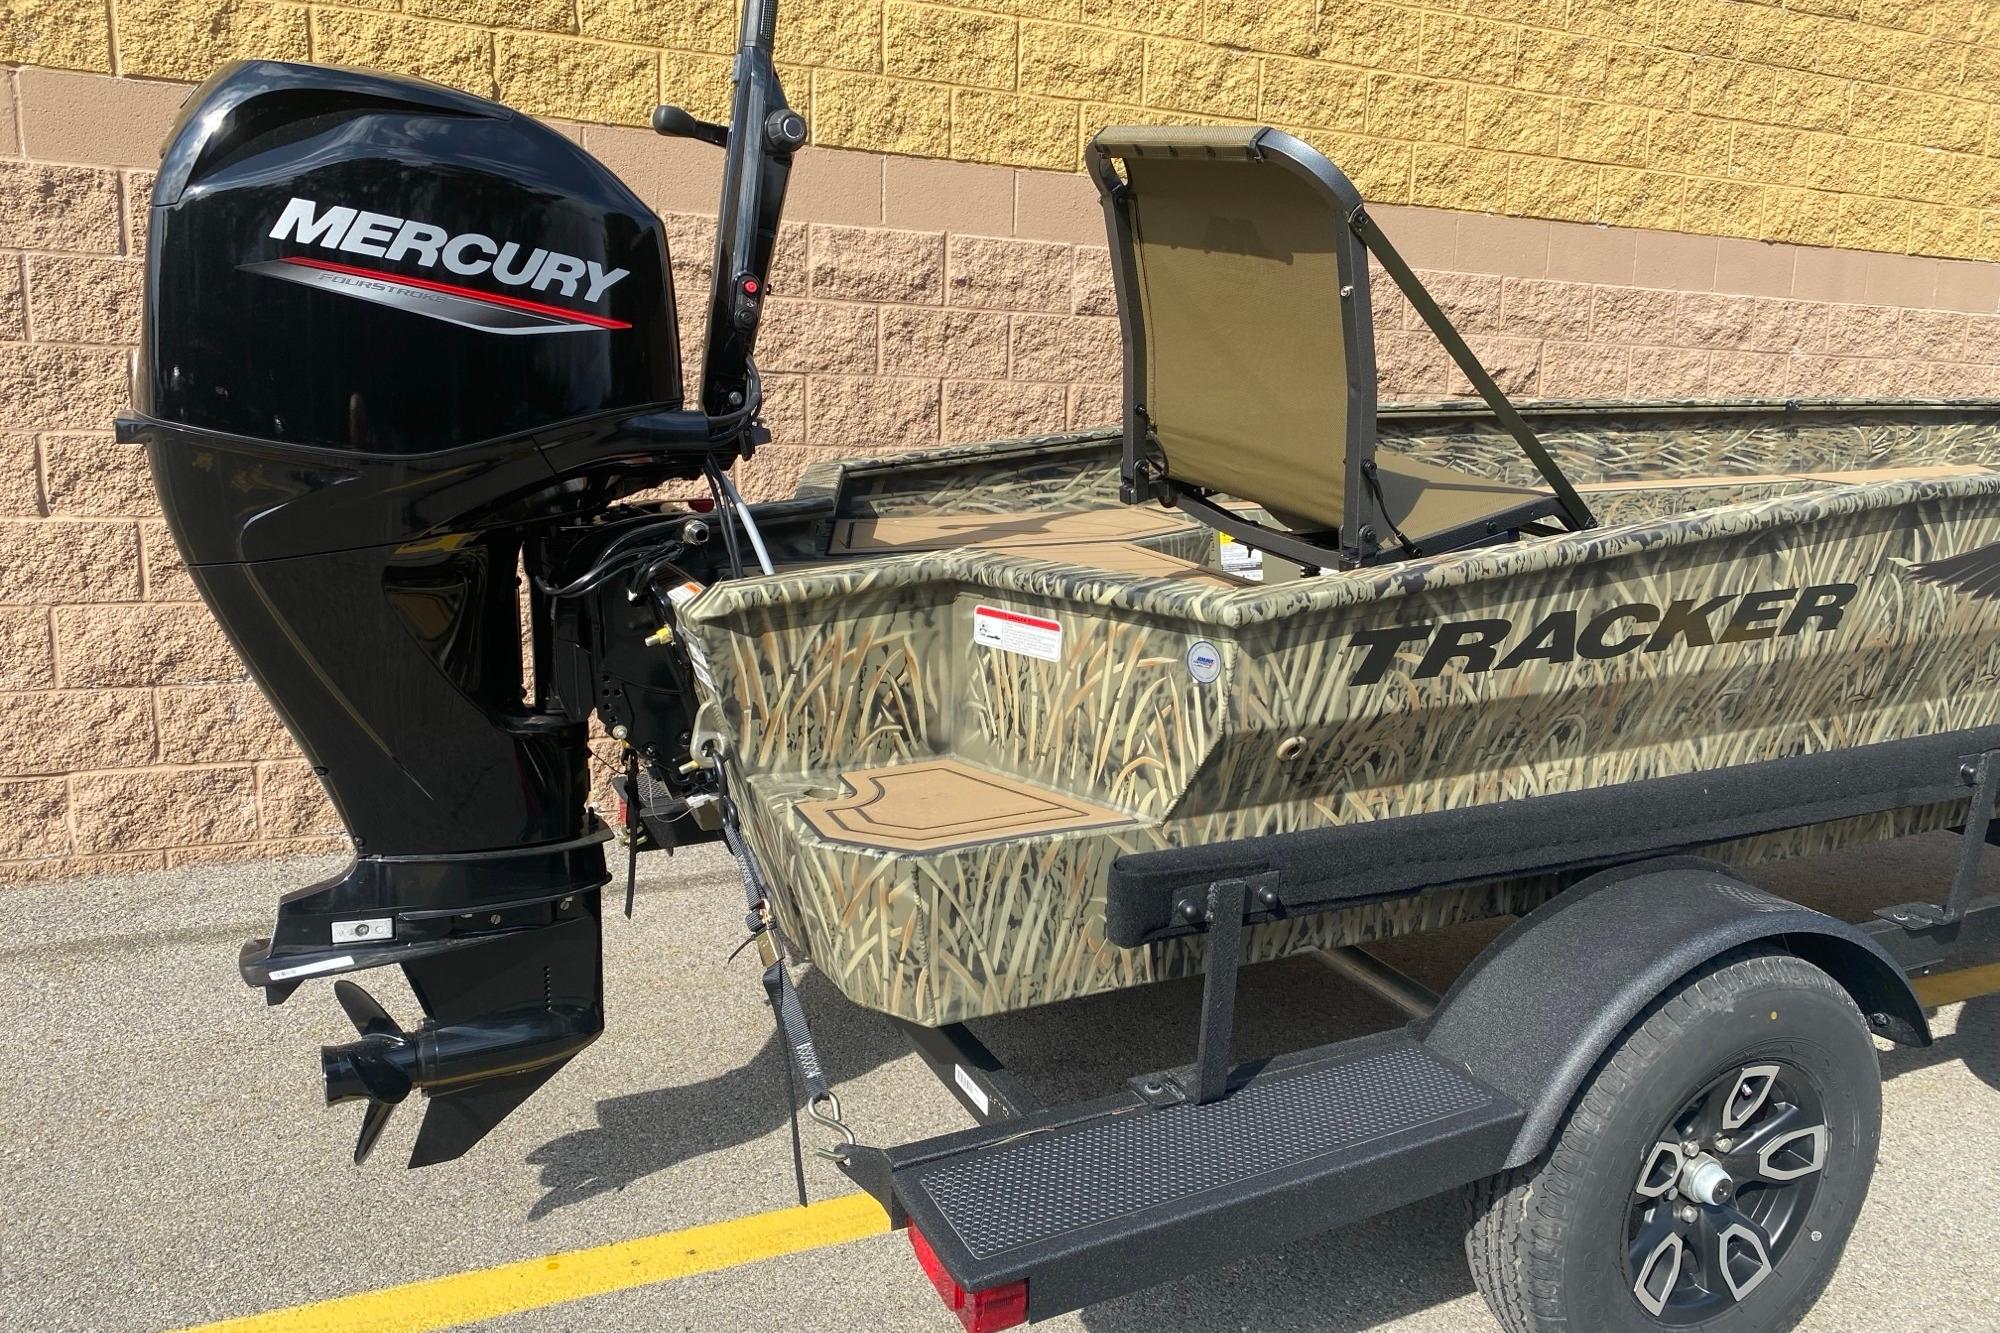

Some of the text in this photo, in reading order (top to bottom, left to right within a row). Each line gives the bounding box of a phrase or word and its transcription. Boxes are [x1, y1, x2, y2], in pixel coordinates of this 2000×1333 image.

[268, 197, 631, 303] MERCURY
[318, 273, 449, 303] FOURSTROKE
[1347, 583, 1859, 687] TRACKER
